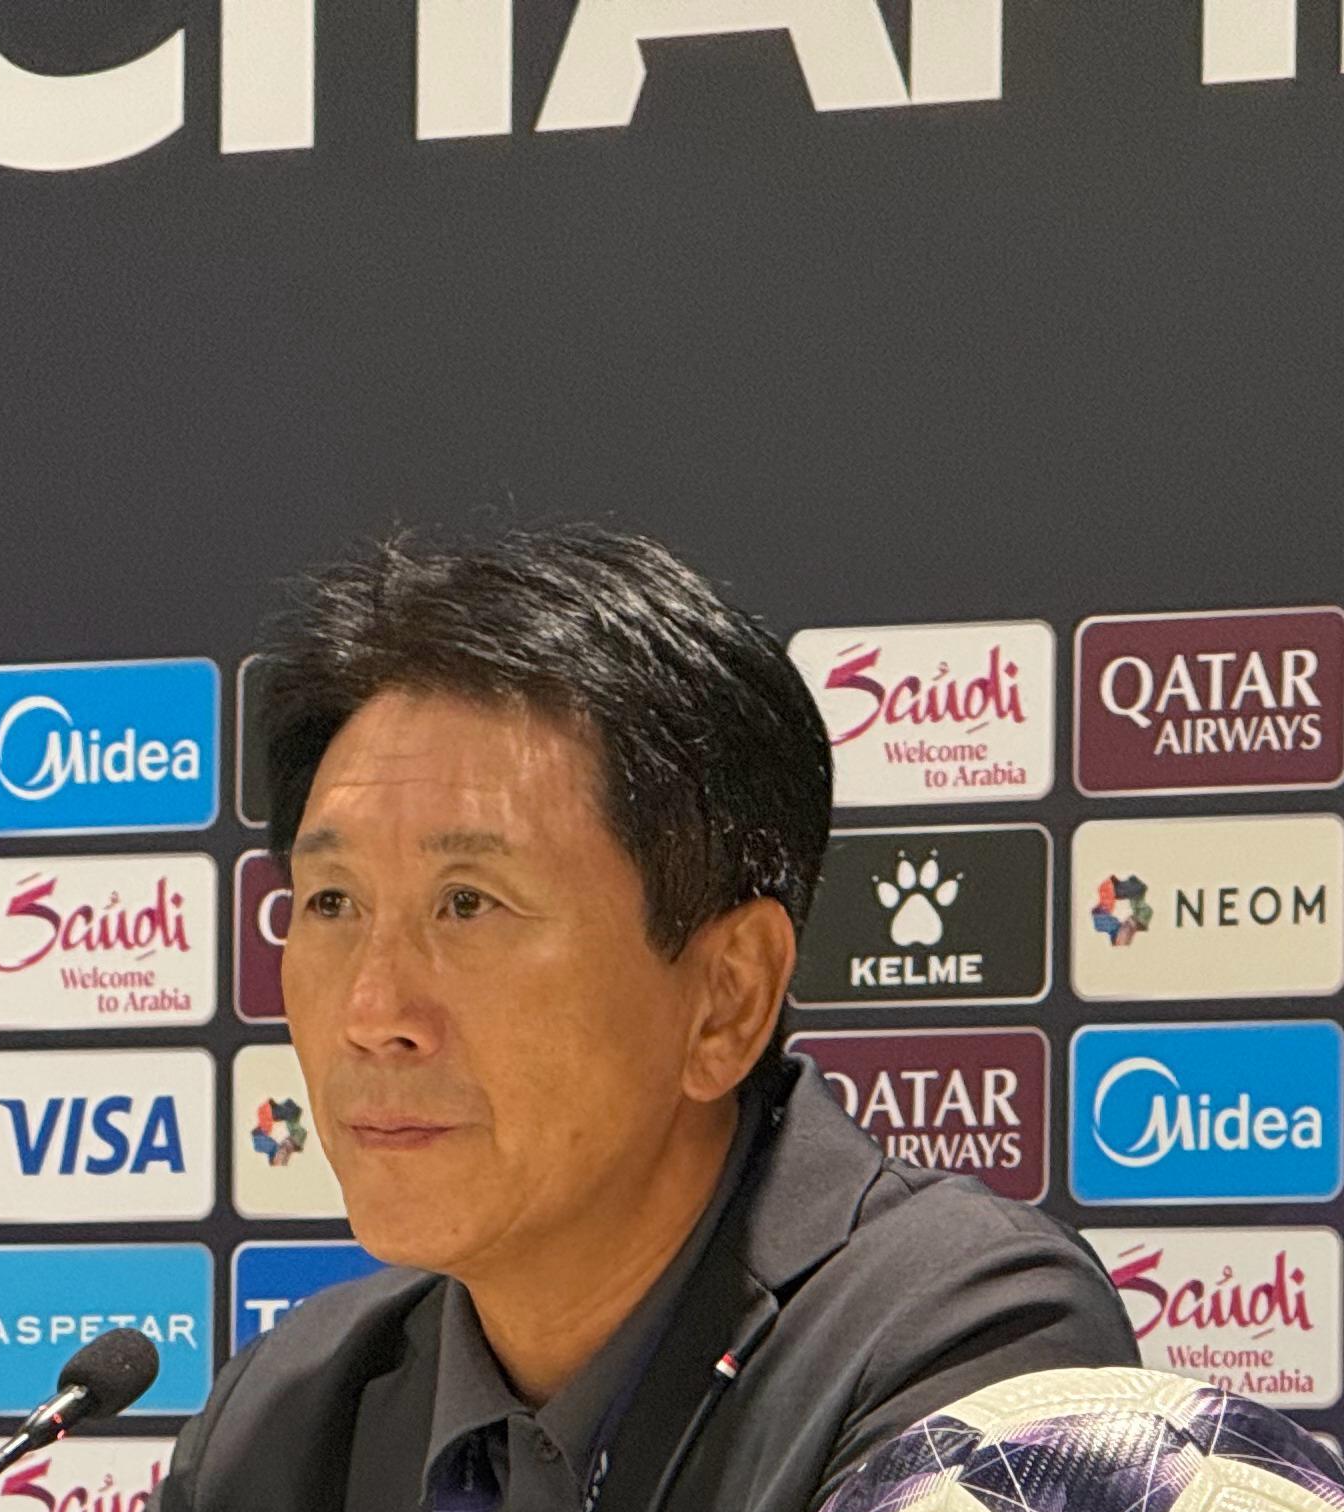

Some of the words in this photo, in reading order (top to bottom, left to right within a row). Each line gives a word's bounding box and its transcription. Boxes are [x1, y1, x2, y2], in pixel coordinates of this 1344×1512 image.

[824, 643, 1026, 747] Saudi
[1100, 648, 1320, 727] QATAR
[883, 740, 988, 765] Welcome
[1154, 714, 1321, 755] AIRWAYS
[27, 730, 200, 787] Midea
[924, 769, 948, 788] to
[952, 762, 1027, 787] Arabia
[1174, 885, 1326, 927] NEOM
[60, 967, 155, 990] Welcome
[850, 955, 982, 987] KELME
[98, 993, 120, 1013] to
[122, 990, 192, 1013] Arabia
[1128, 1094, 1323, 1151] Midea
[871, 1132, 1022, 1168] IRWAYS
[1111, 1244, 1314, 1340] Saudi
[1167, 1345, 1274, 1368] Welcome
[1238, 1369, 1314, 1394] Arabia
